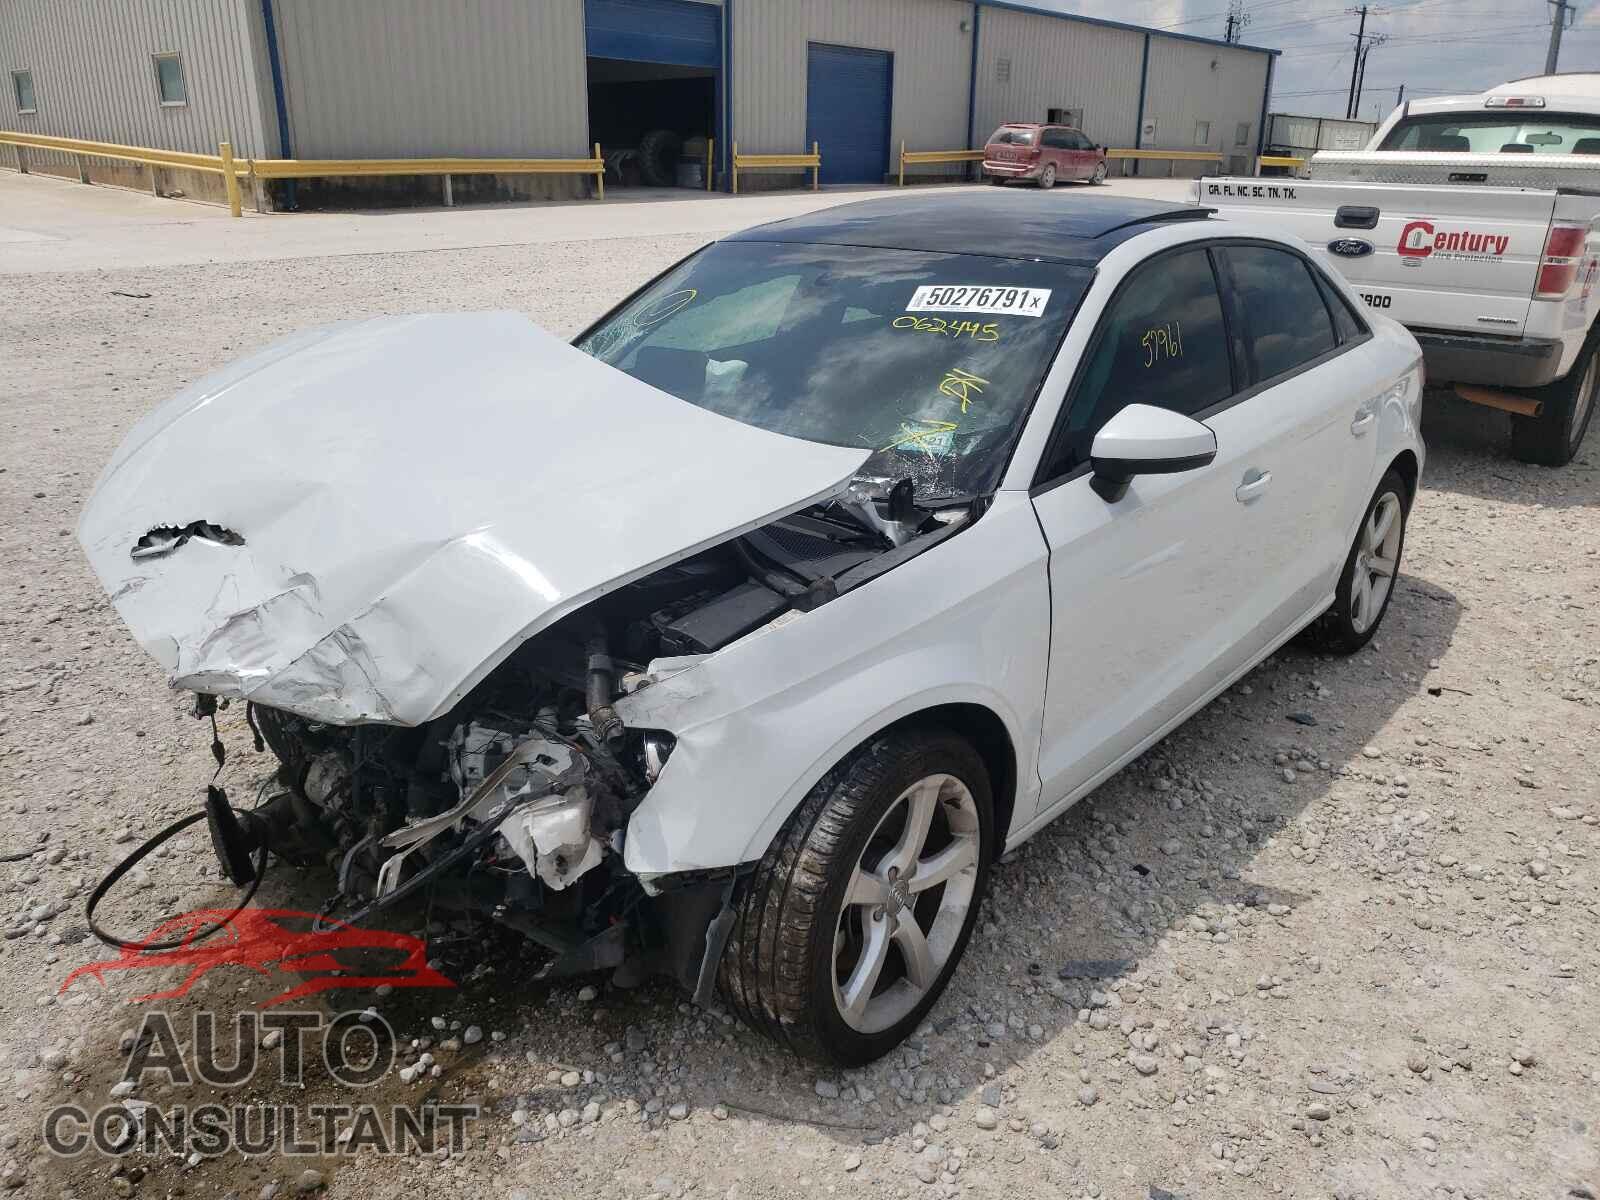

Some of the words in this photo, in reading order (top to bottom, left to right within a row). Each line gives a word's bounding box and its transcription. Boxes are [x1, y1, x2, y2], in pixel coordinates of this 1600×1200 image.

[1223, 185, 1235, 196] FL.
[1237, 186, 1250, 197] NC.
[1252, 186, 1265, 198] SC.
[1267, 187, 1280, 199] TN.
[1282, 188, 1297, 200] TX.
[1396, 221, 1510, 257] Century
[926, 287, 1030, 309] 50276791
[1359, 293, 1392, 309] 900
[892, 316, 1000, 343] 062445
